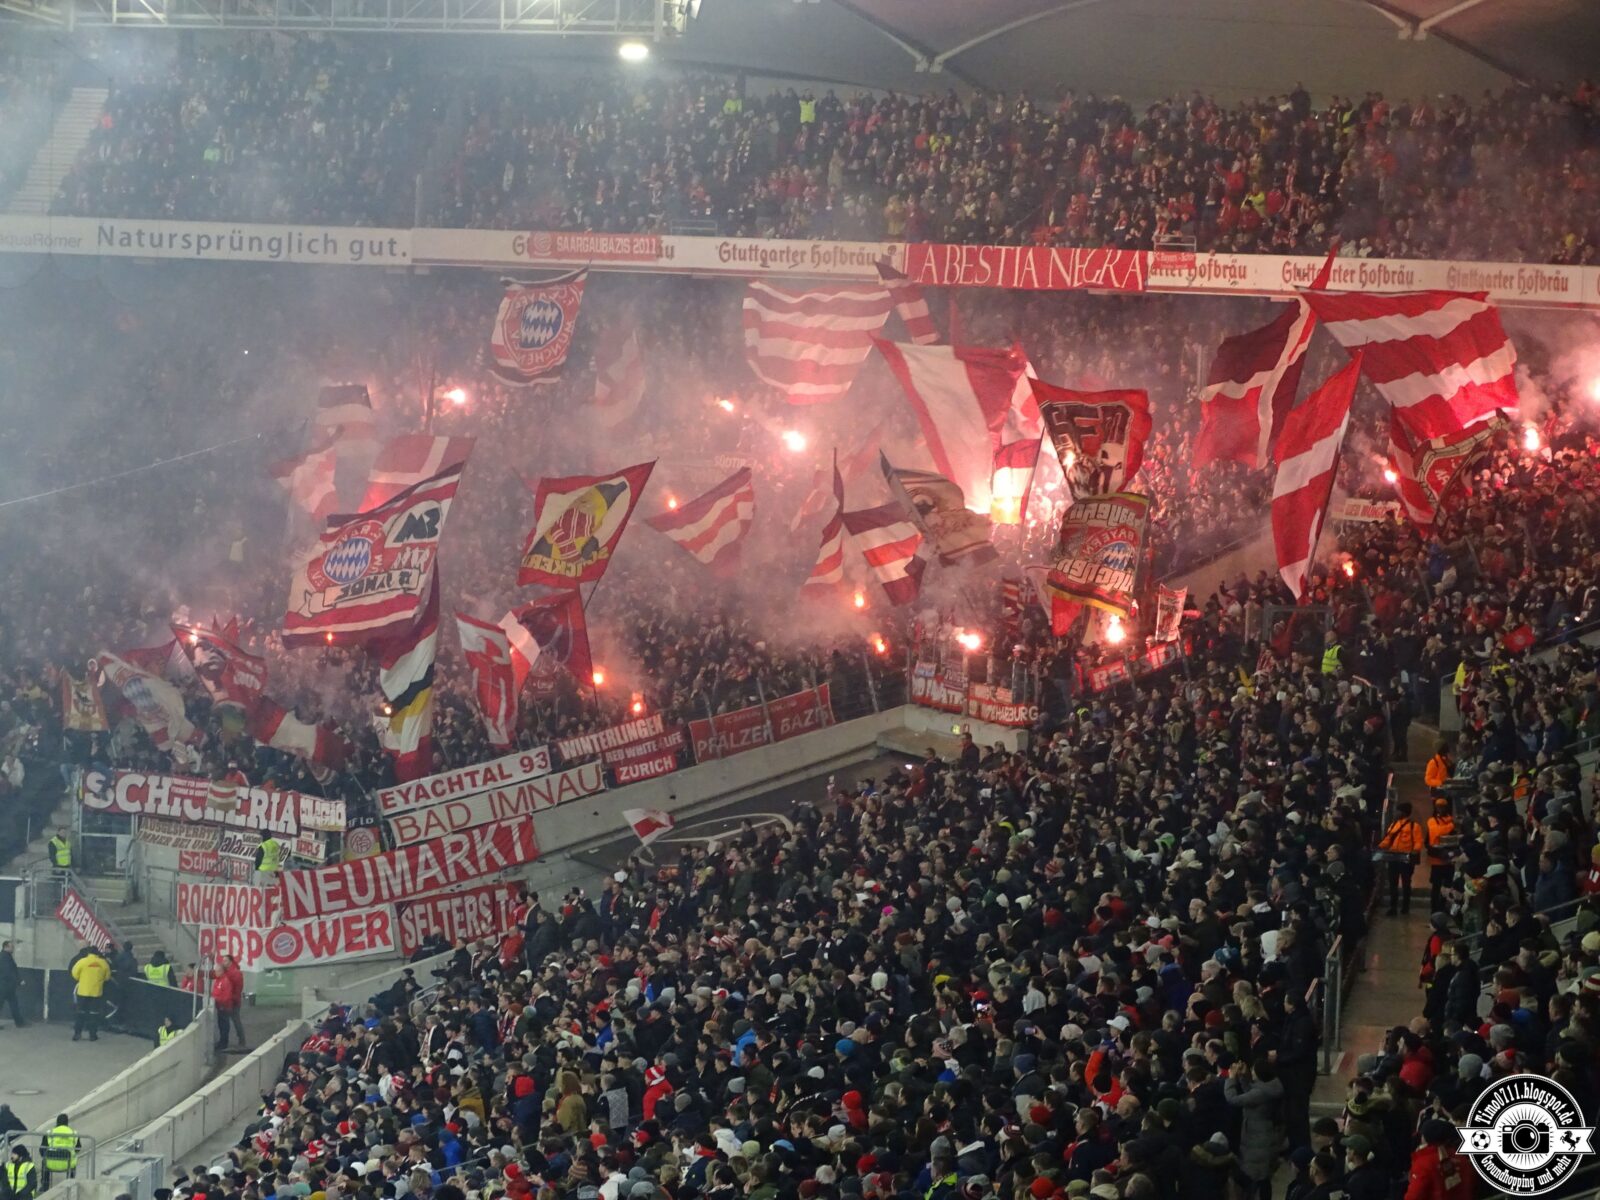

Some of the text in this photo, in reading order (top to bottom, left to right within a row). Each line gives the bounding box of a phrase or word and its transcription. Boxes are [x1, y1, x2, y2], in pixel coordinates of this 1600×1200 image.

[97, 225, 409, 261] Natursprünglich gut.
[556, 235, 631, 254] SAARGAUBAZIS
[632, 237, 657, 255] 2011
[719, 241, 876, 269] Stuttgarter Hofbräu
[943, 245, 1038, 288] BESTIA
[1047, 248, 1144, 291] NEGRA
[1282, 260, 1414, 289] Stuttrter Hofbräu
[1518, 267, 1569, 294] Hofbräu
[558, 713, 664, 759] WINTERLINGEN
[605, 749, 625, 763] RED
[626, 741, 658, 758] WHITE
[84, 771, 298, 836] SCHICERIA
[380, 751, 549, 810] EYACHTAL 93
[394, 764, 603, 844] BAD IMNAU
[284, 818, 527, 918] NEUMARKT
[178, 883, 280, 929] ROHRDORF
[401, 891, 494, 950] SELTERS
[247, 910, 394, 967] POWER
